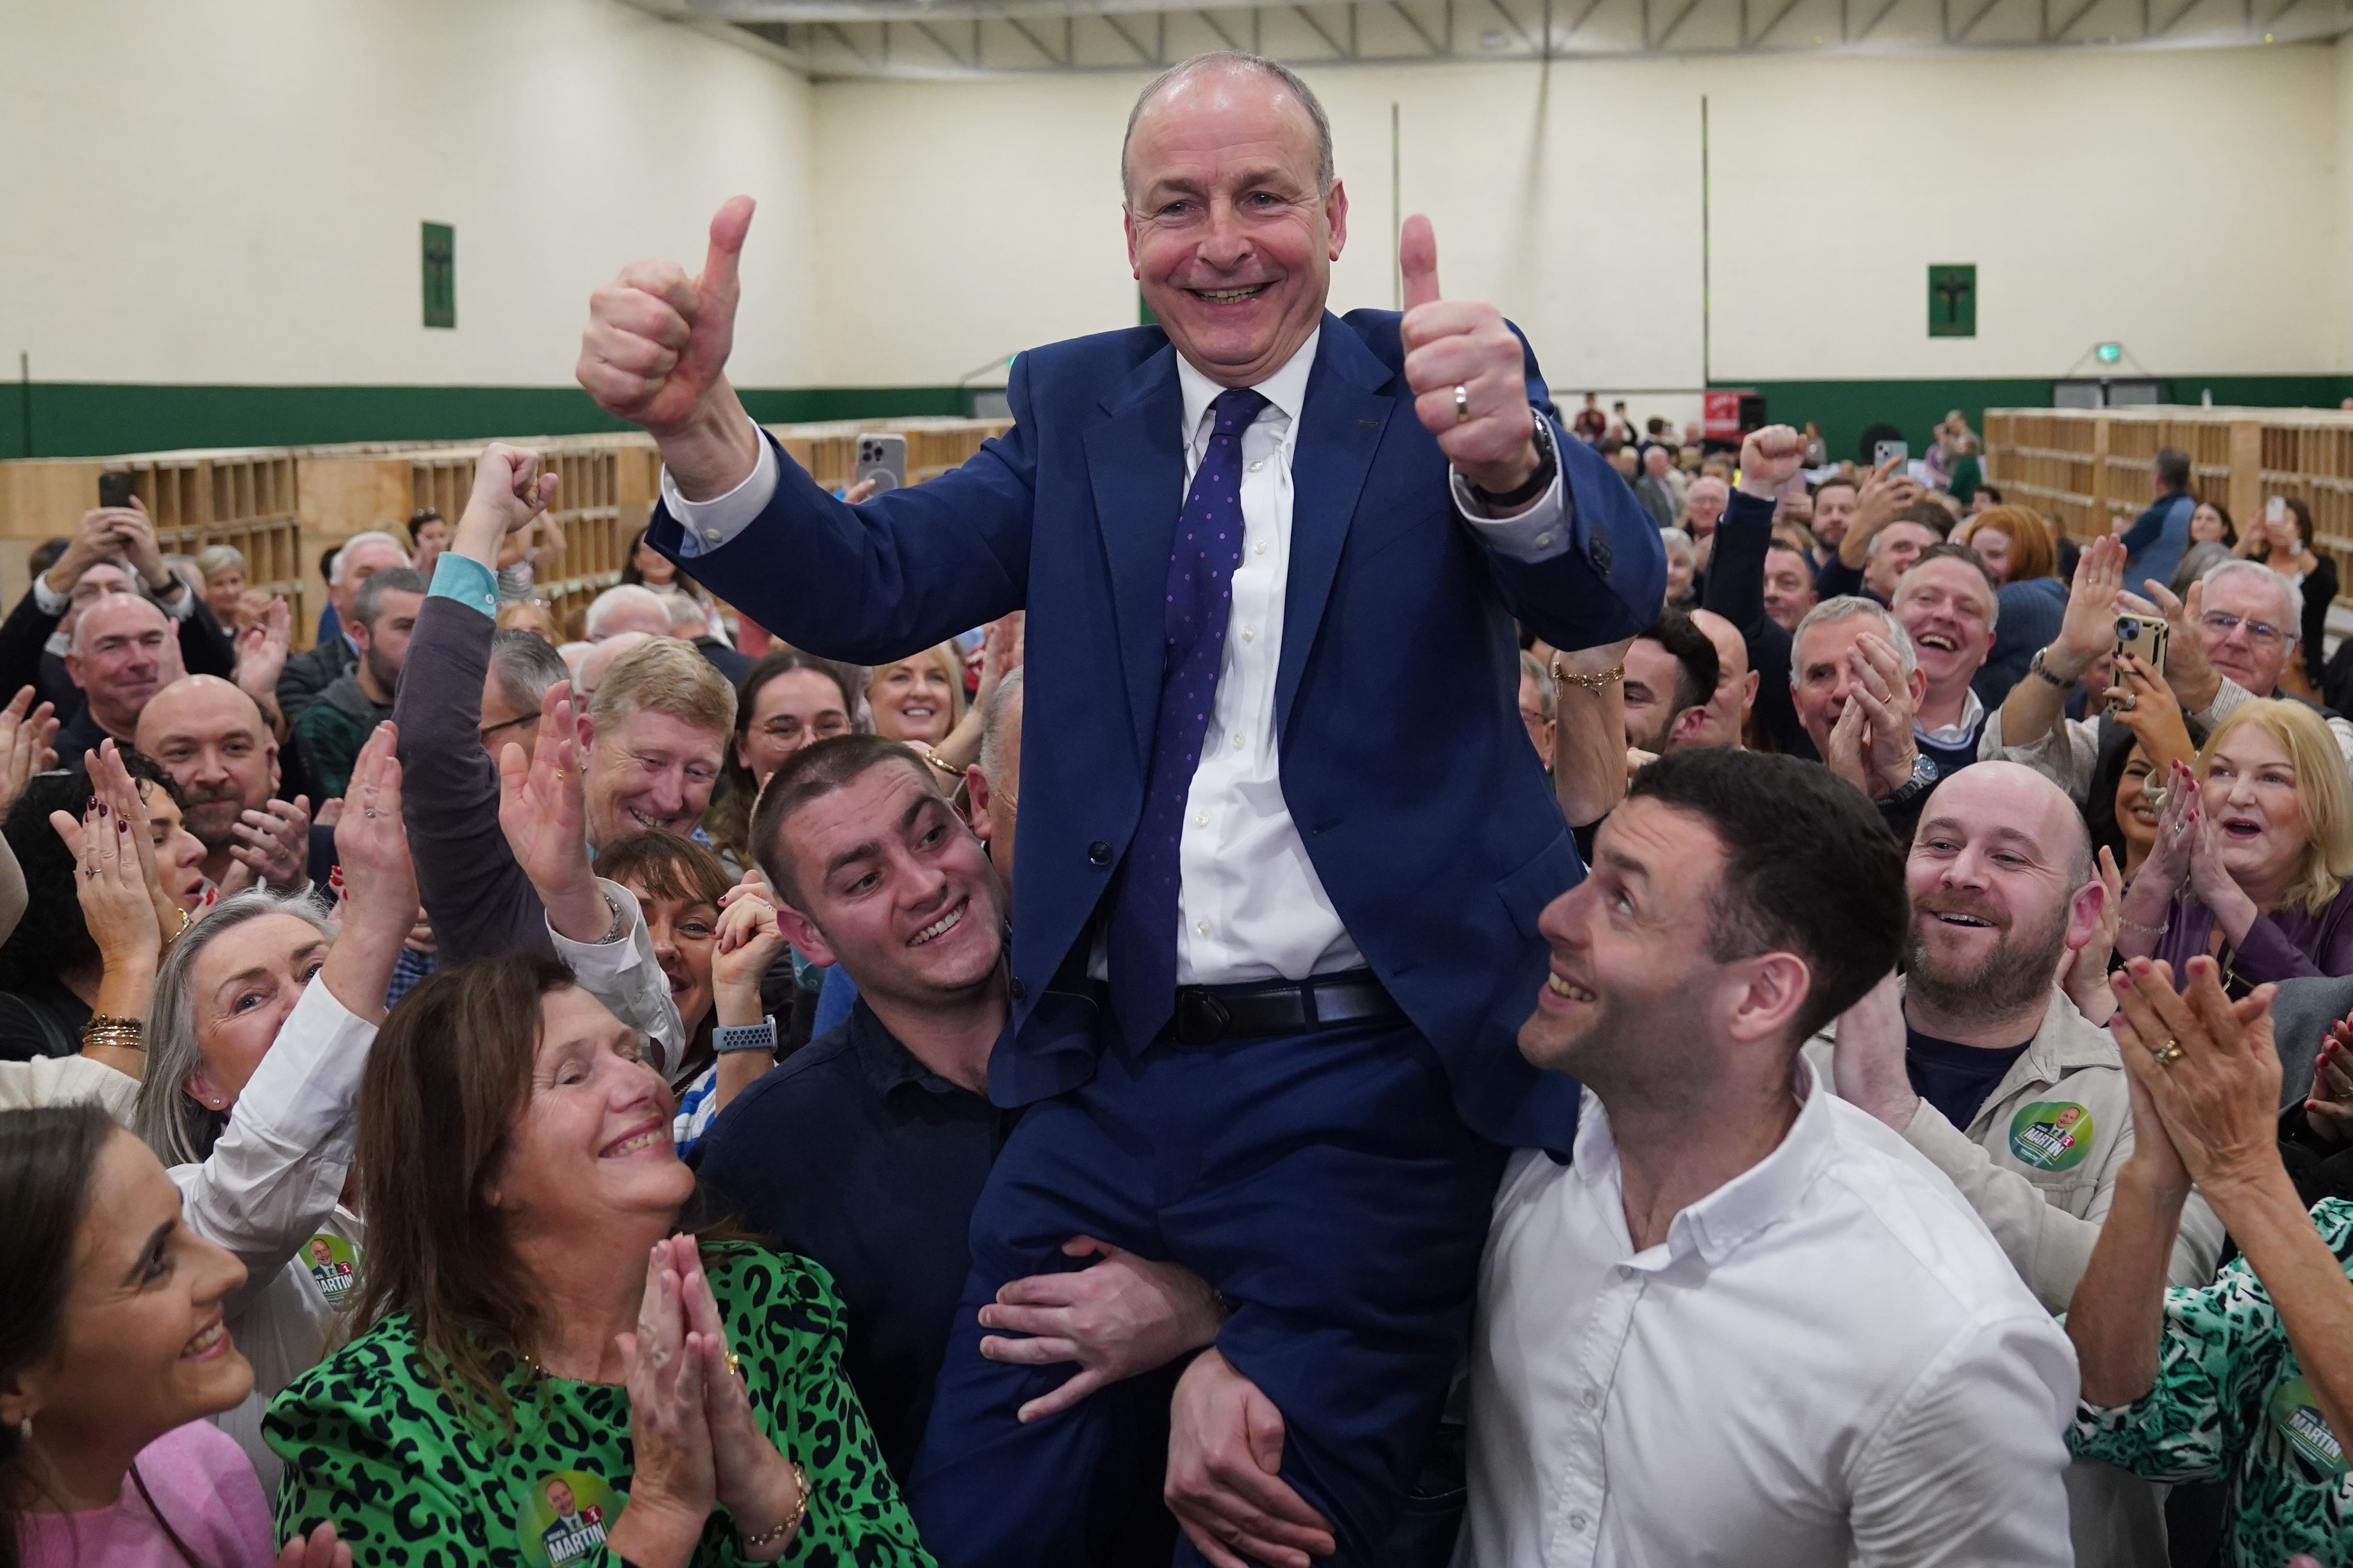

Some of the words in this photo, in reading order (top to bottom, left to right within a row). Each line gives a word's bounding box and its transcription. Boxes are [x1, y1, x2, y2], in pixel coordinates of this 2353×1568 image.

[2024, 1128, 2065, 1157] MARTIN
[2064, 1138, 2071, 1146] 1
[343, 1265, 350, 1273] 1
[2289, 1413, 2342, 1458] MARTIN
[590, 1509, 599, 1521] 1
[549, 1522, 607, 1563] MARTIN
